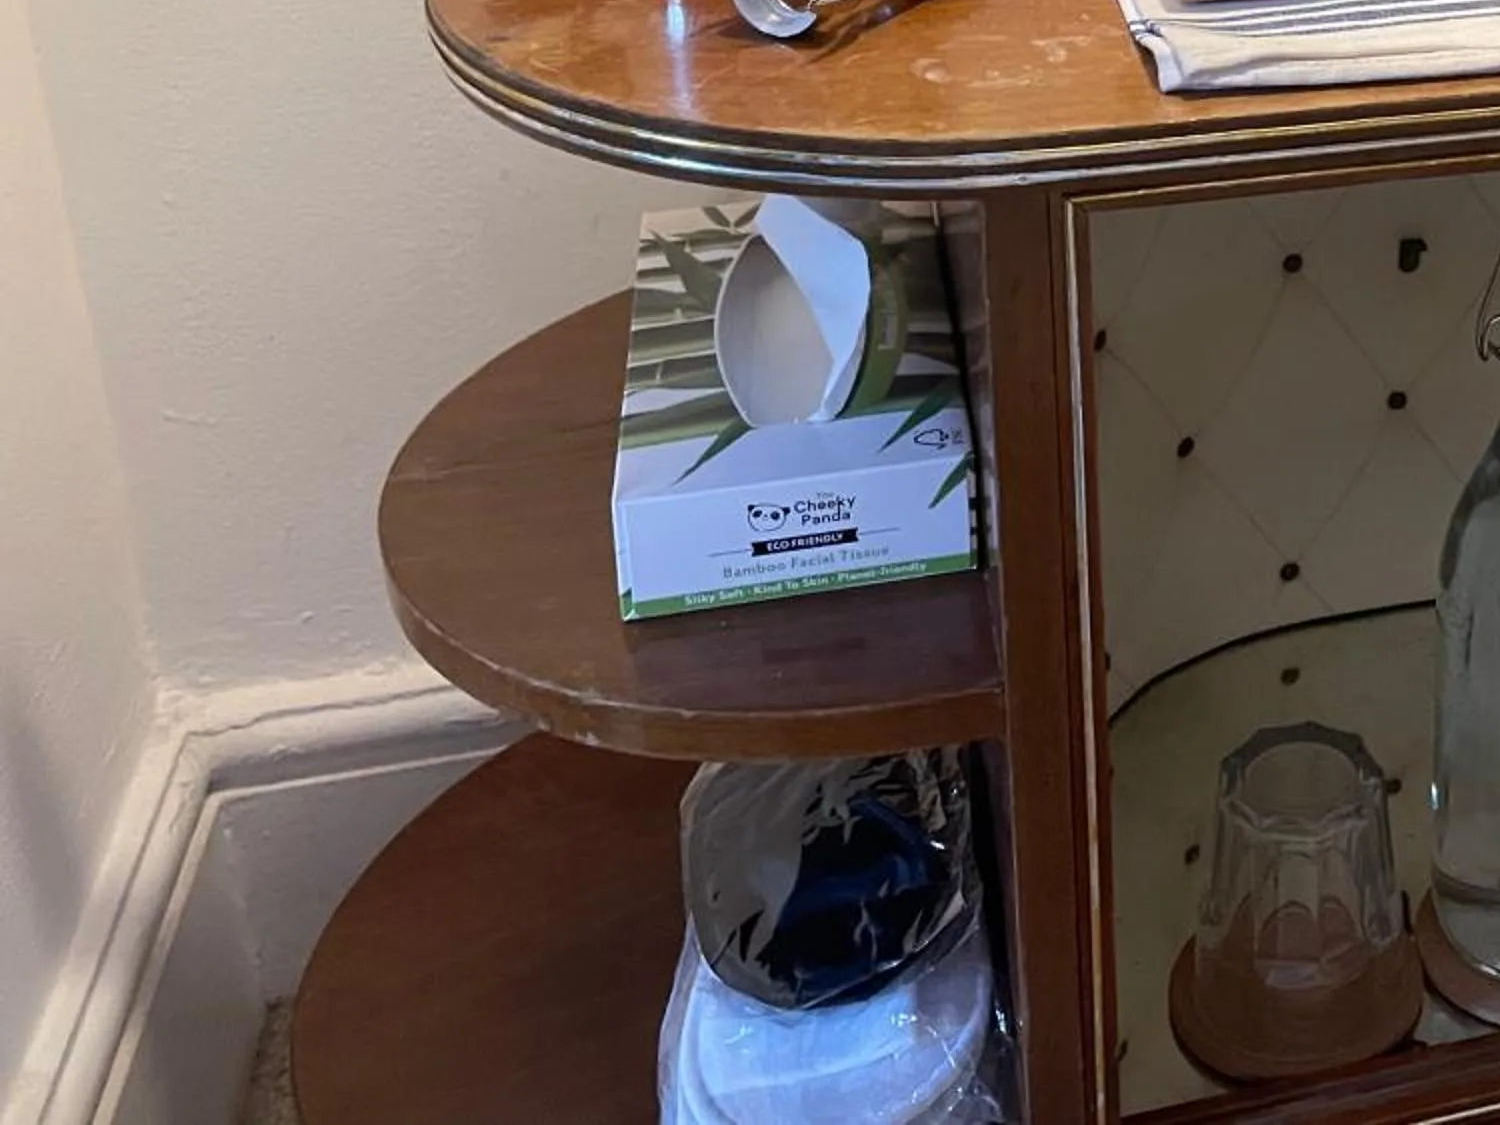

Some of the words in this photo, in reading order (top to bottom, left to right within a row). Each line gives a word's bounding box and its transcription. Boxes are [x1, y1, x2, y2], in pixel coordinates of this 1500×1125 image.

[794, 495, 857, 514] Cheeky
[801, 509, 851, 526] Panda
[723, 562, 786, 578] Bamboo
[791, 551, 835, 569] Facial
[840, 545, 889, 560] Tissue
[684, 593, 716, 606] Silky
[719, 588, 743, 600] Soft
[754, 581, 783, 594] Kind
[802, 575, 829, 588] Skin
